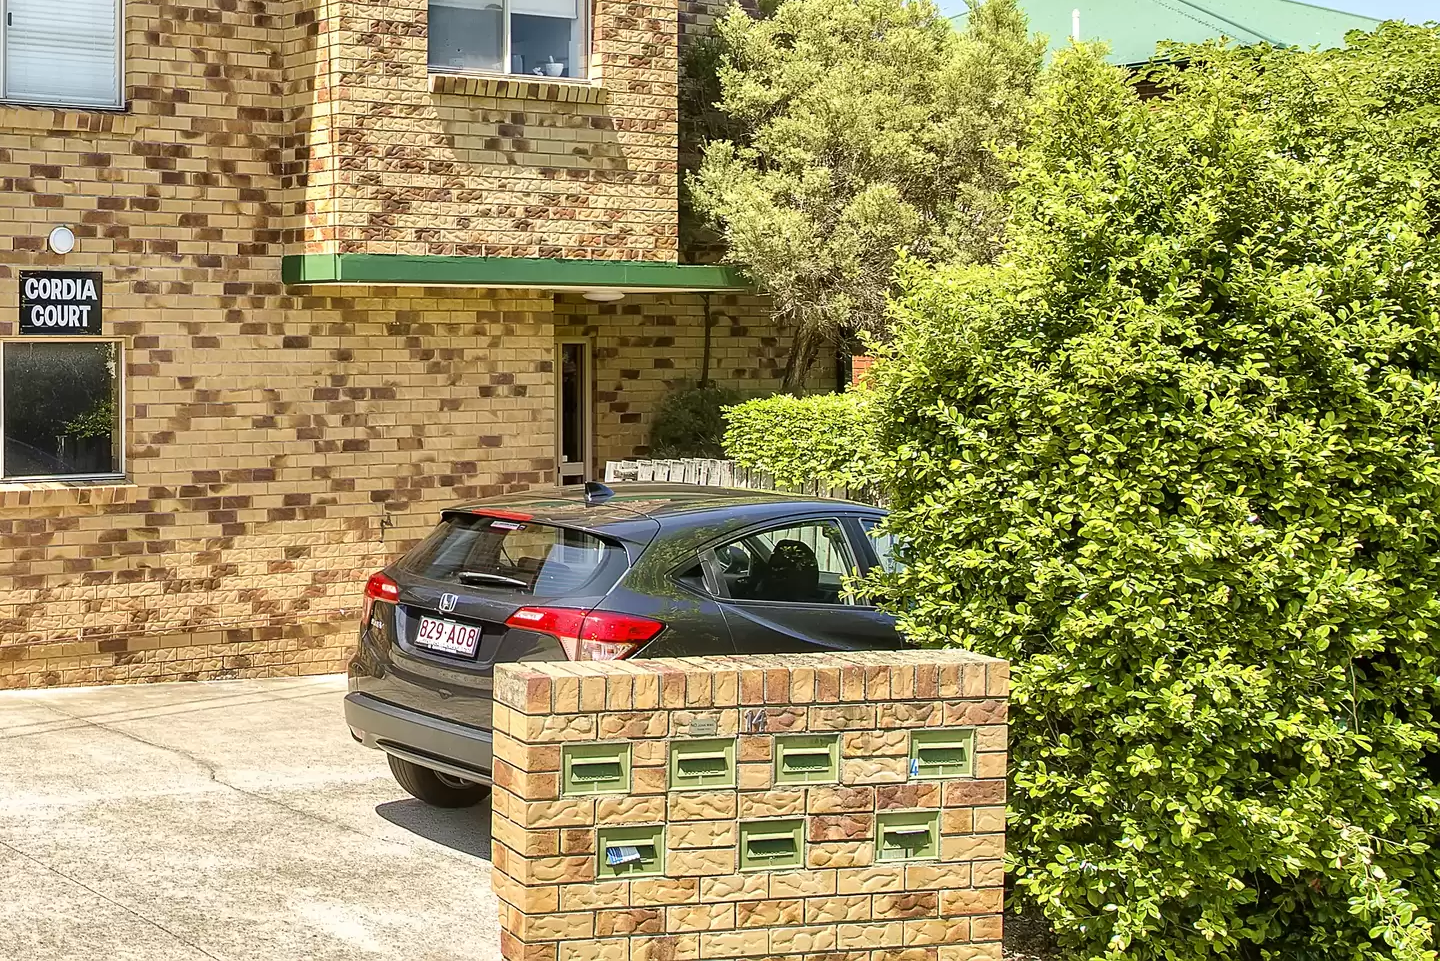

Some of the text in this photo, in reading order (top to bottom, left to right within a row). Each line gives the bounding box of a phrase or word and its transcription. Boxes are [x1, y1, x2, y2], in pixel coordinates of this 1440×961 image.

[25, 277, 98, 301] CORDIA
[31, 304, 92, 327] COURT
[745, 709, 767, 732] 14
[909, 758, 919, 776] 4
